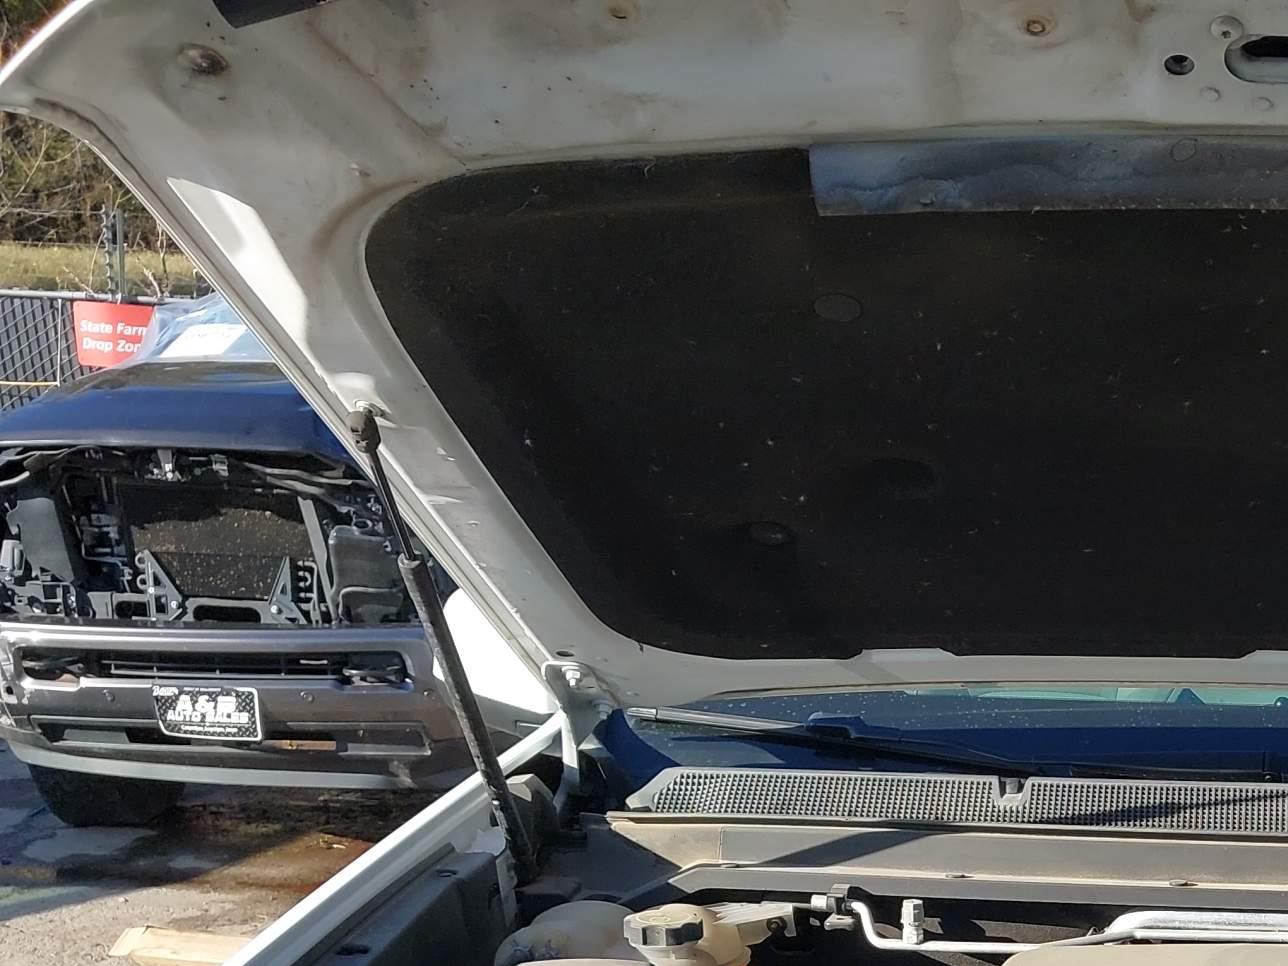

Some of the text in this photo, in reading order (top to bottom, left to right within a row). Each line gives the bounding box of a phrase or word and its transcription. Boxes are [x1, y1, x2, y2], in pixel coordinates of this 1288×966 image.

[80, 319, 113, 334] State
[82, 337, 113, 353] Drop
[166, 709, 249, 724] AUTO SALES
